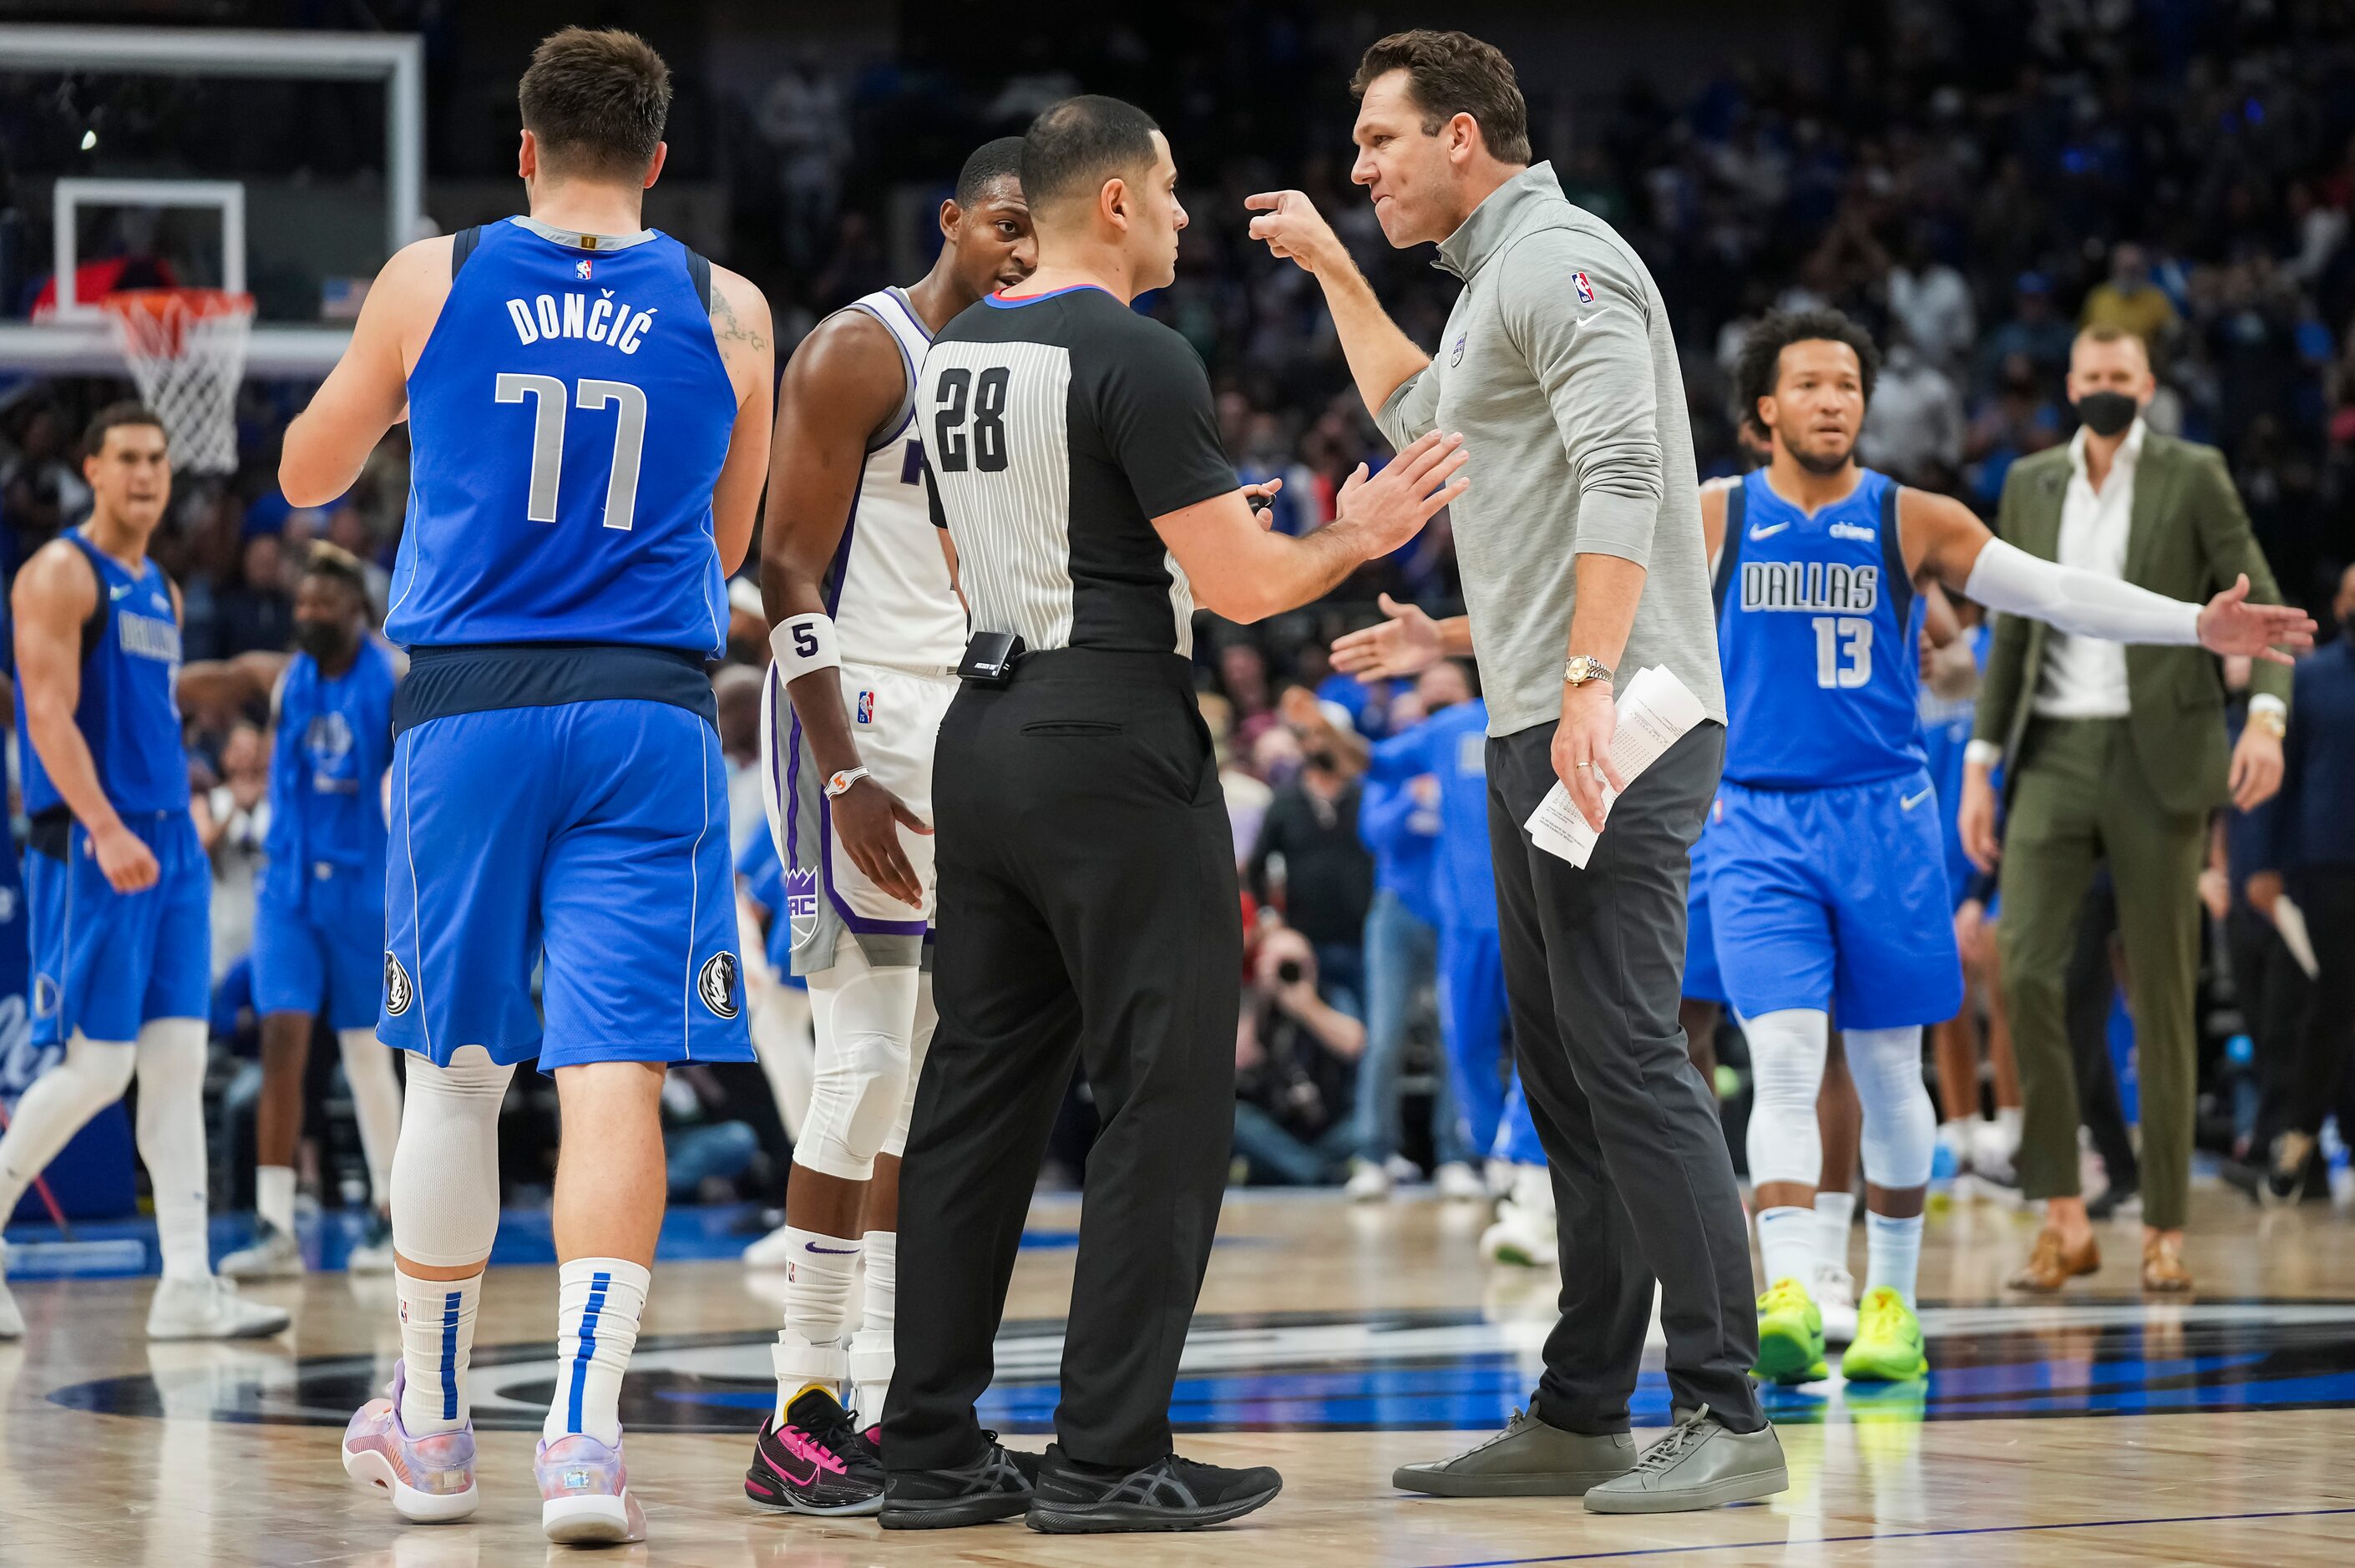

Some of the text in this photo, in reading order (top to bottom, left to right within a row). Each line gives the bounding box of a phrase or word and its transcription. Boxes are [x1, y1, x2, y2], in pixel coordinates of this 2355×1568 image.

[506, 288, 658, 355] DONČIĆ
[495, 372, 647, 531] 77
[935, 367, 1010, 472] 28
[1741, 561, 1878, 615] DALLAS
[792, 623, 818, 658] 5
[1812, 617, 1873, 689] 13
[788, 898, 816, 916] AC
